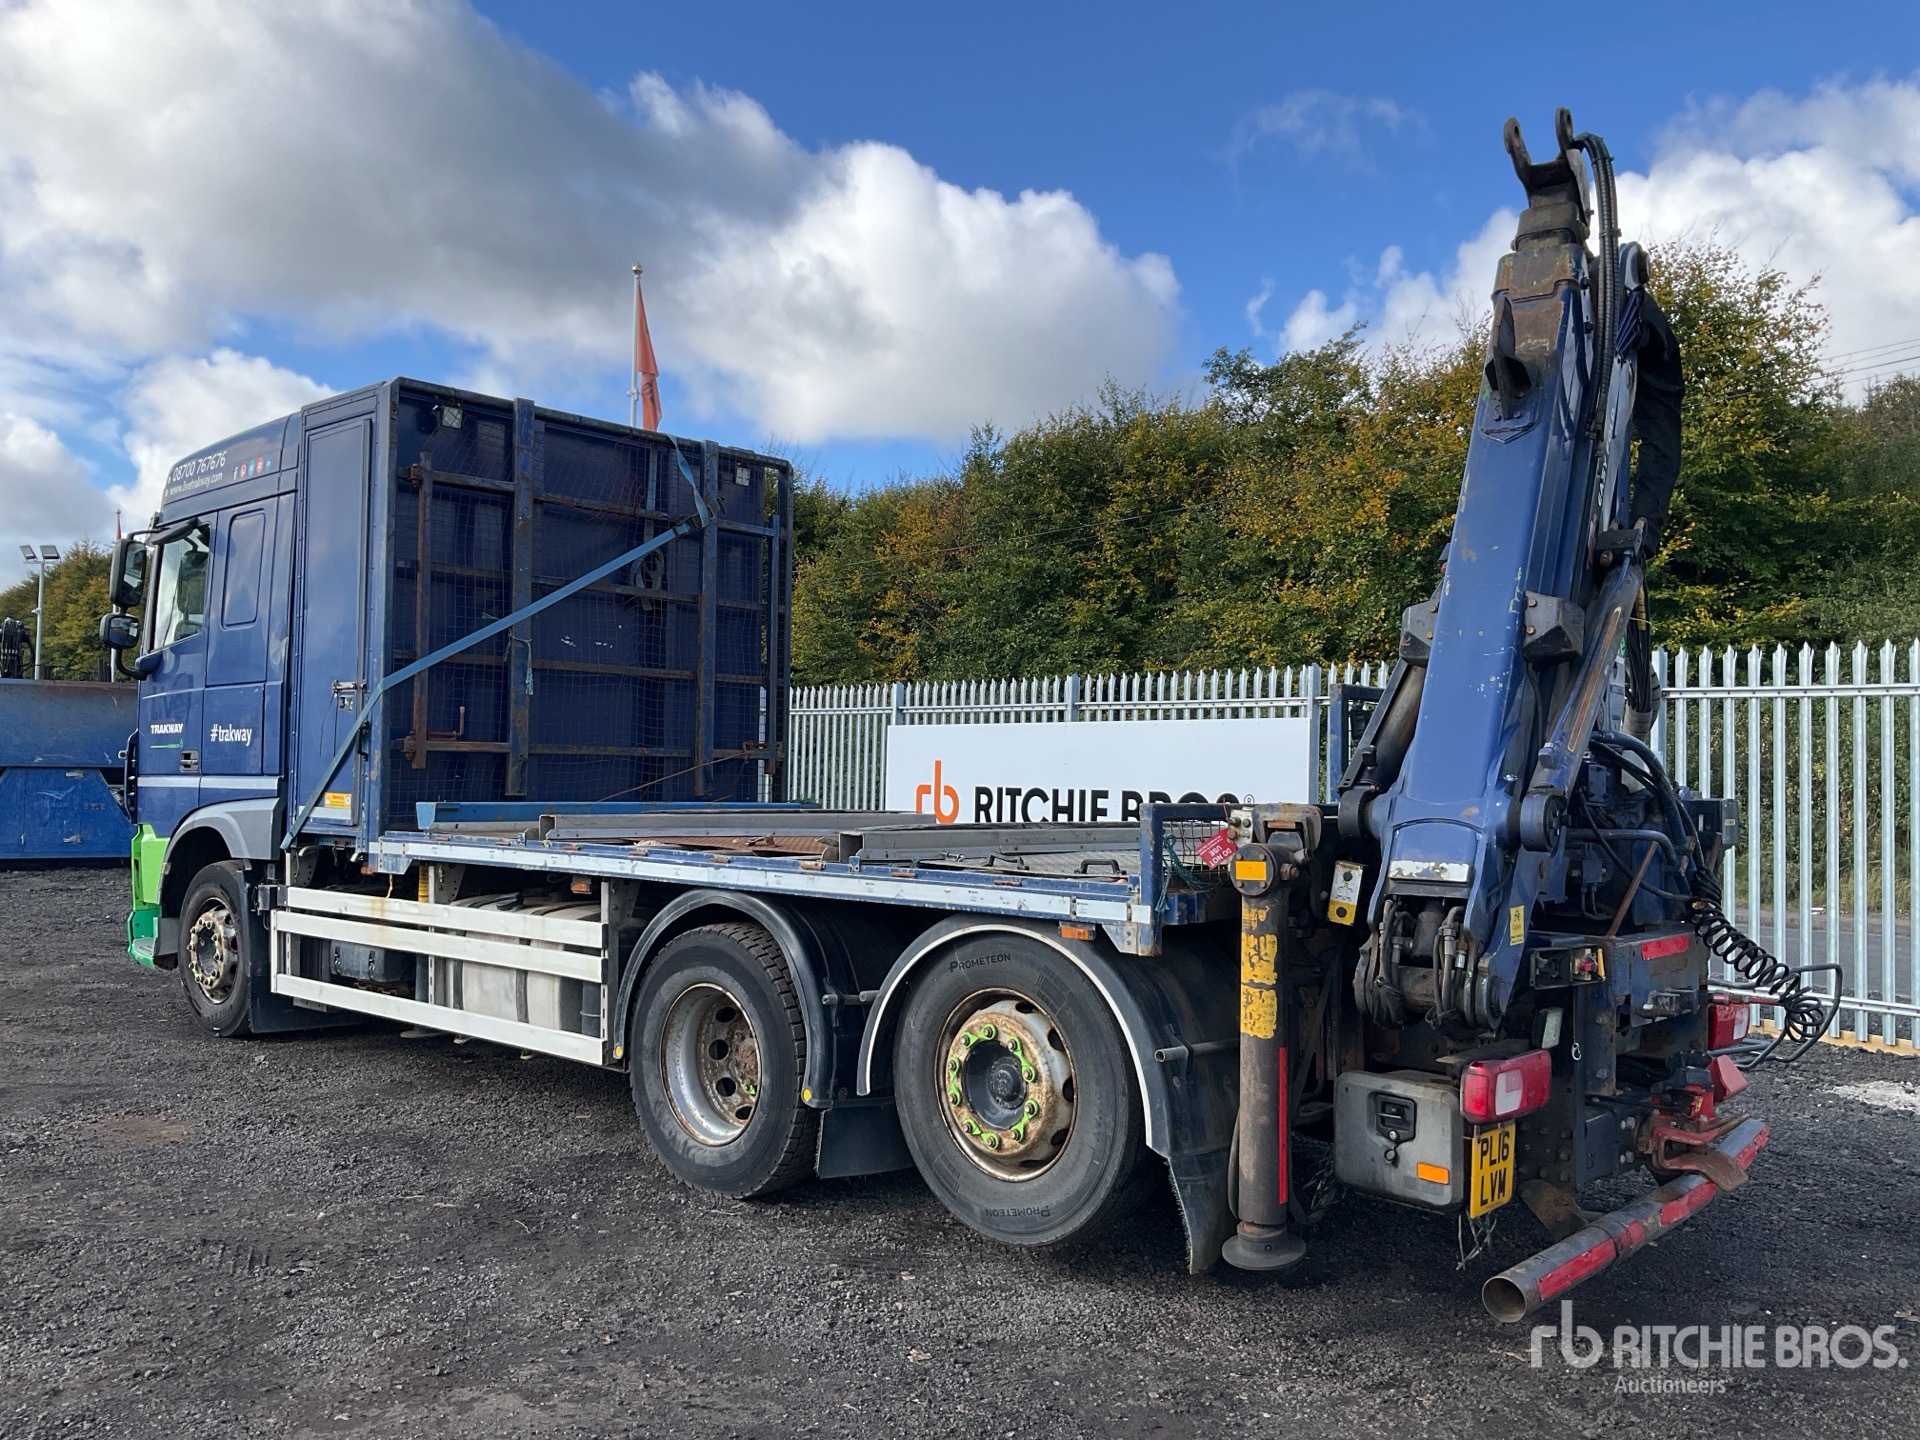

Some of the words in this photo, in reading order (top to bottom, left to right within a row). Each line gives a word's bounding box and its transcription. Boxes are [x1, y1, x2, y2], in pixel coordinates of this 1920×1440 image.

[172, 460, 196, 482] 08700
[196, 450, 228, 475] 767676
[150, 723, 184, 735] TRAKWAY
[210, 723, 253, 747] #trakway
[974, 786, 1110, 823] RITCHIE
[1208, 845, 1223, 857] USE
[1222, 847, 1233, 857] DO
[1209, 853, 1224, 867] NOT
[949, 952, 1012, 973] PROMETEON
[1480, 1130, 1510, 1170] PL16
[984, 1205, 1051, 1218] PROMETEON
